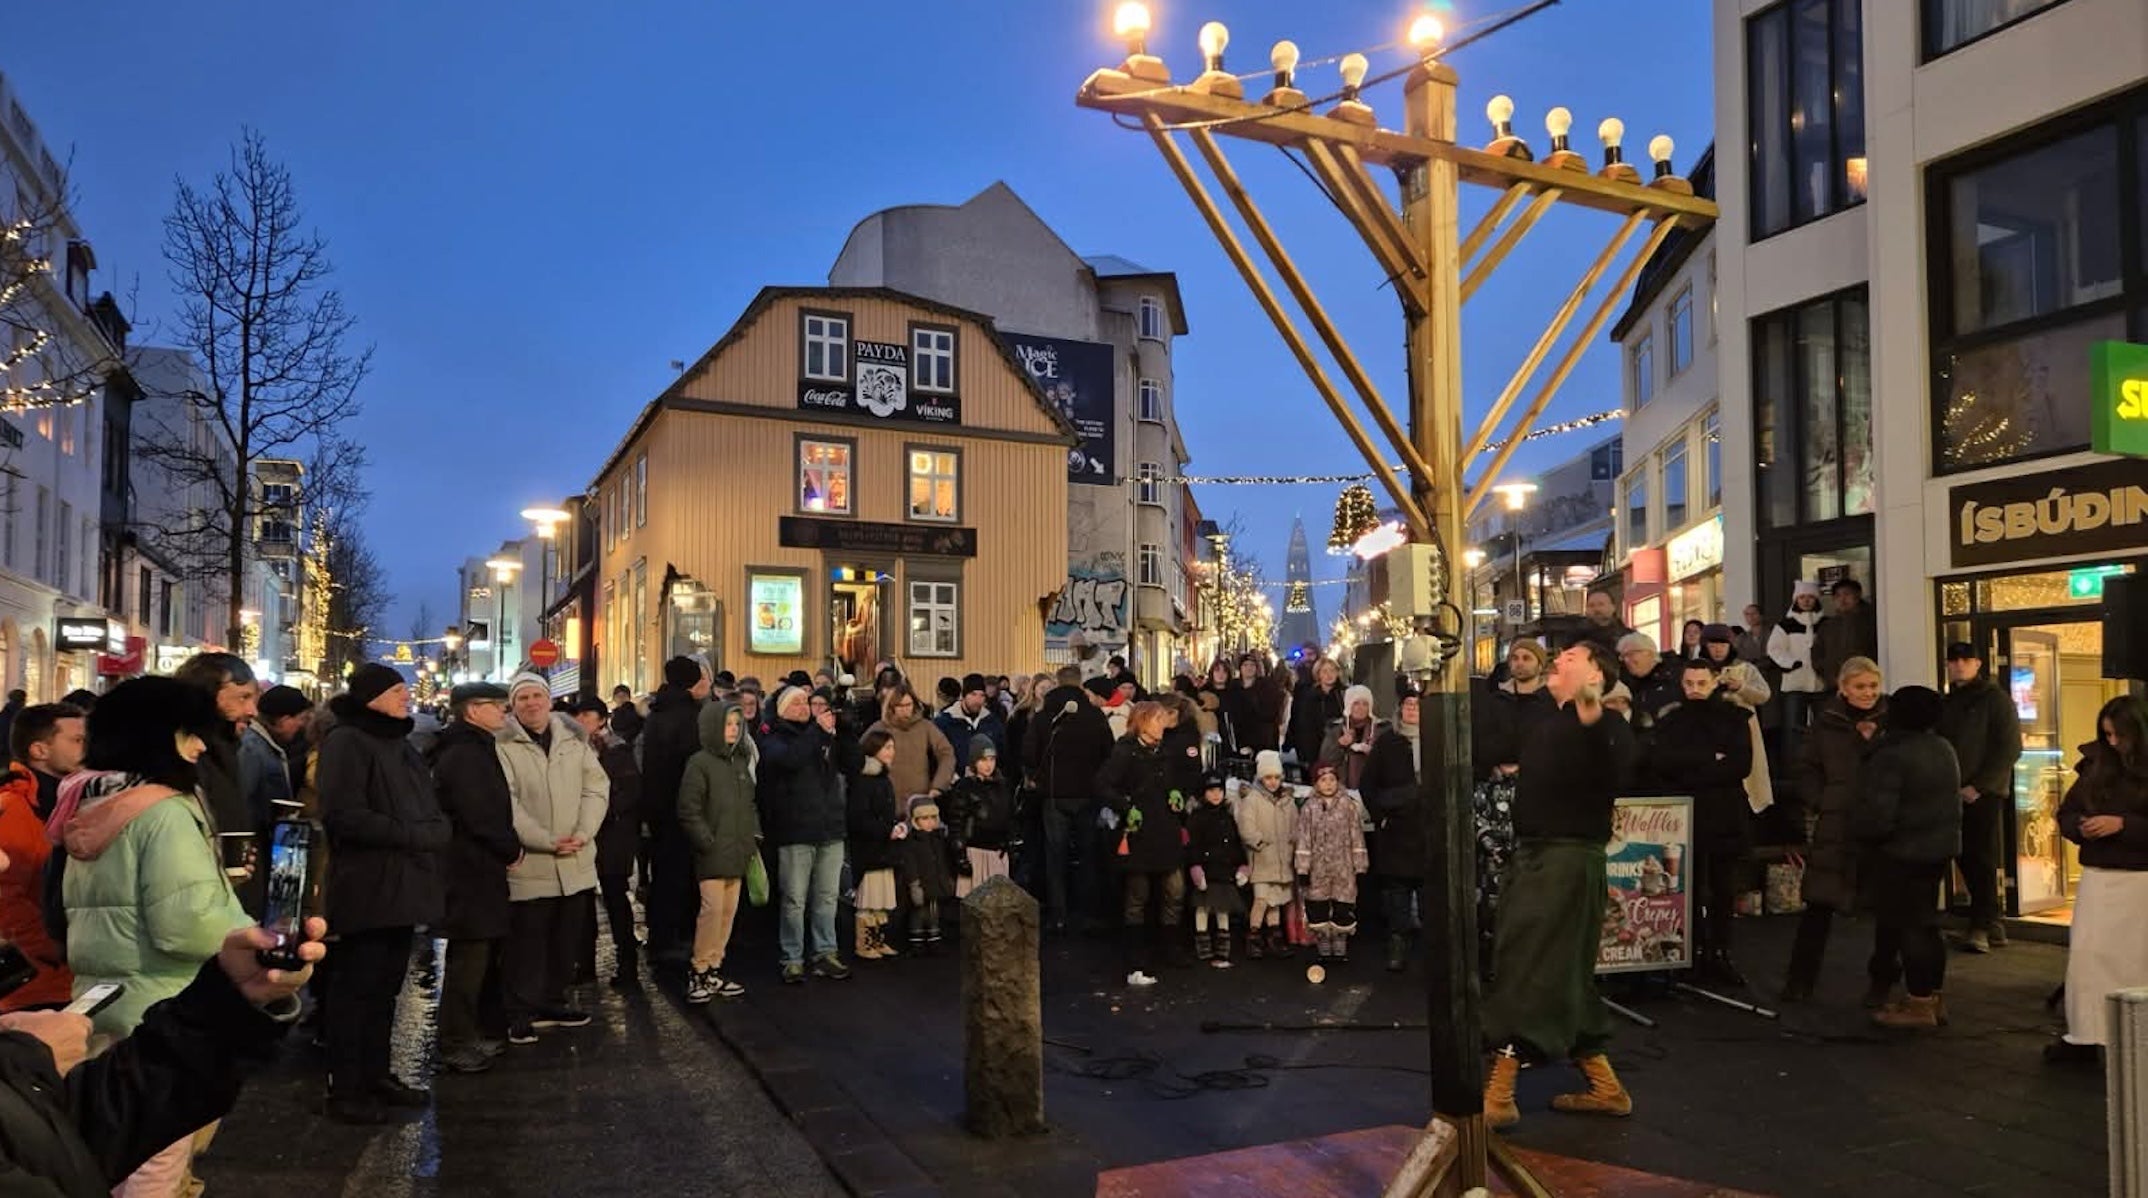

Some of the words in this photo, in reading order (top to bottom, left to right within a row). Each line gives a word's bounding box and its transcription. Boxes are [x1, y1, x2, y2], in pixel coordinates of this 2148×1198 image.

[857, 341, 906, 362] PAYDA
[1015, 344, 1058, 361] Magic
[1025, 358, 1058, 378] ICE
[1620, 809, 1684, 838] Waffles
[1606, 861, 1643, 878] RINKS
[1602, 945, 1643, 961] CREAM
